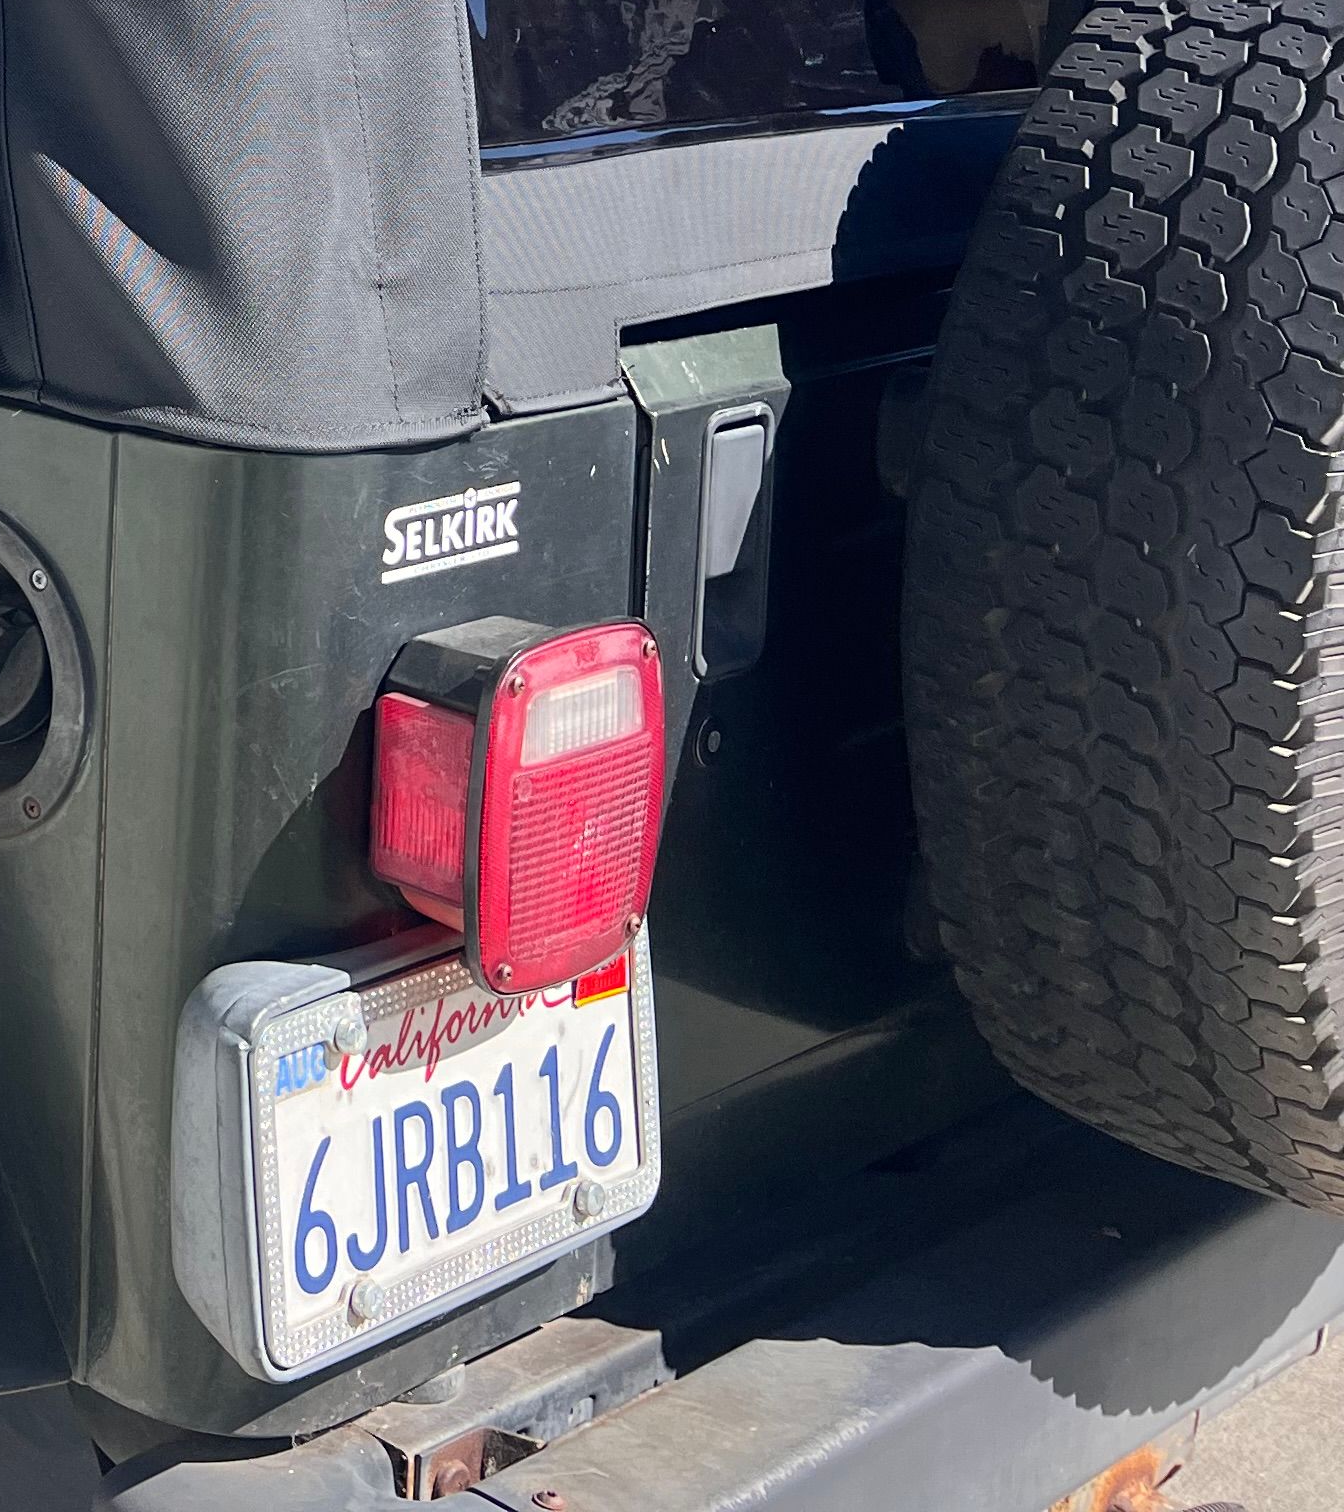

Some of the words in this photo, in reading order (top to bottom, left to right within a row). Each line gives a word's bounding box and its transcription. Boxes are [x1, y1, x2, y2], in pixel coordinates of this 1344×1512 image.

[382, 485, 520, 566] SELKIRK
[275, 1044, 326, 1096] AUG
[295, 1023, 622, 1294] 6JRB116
